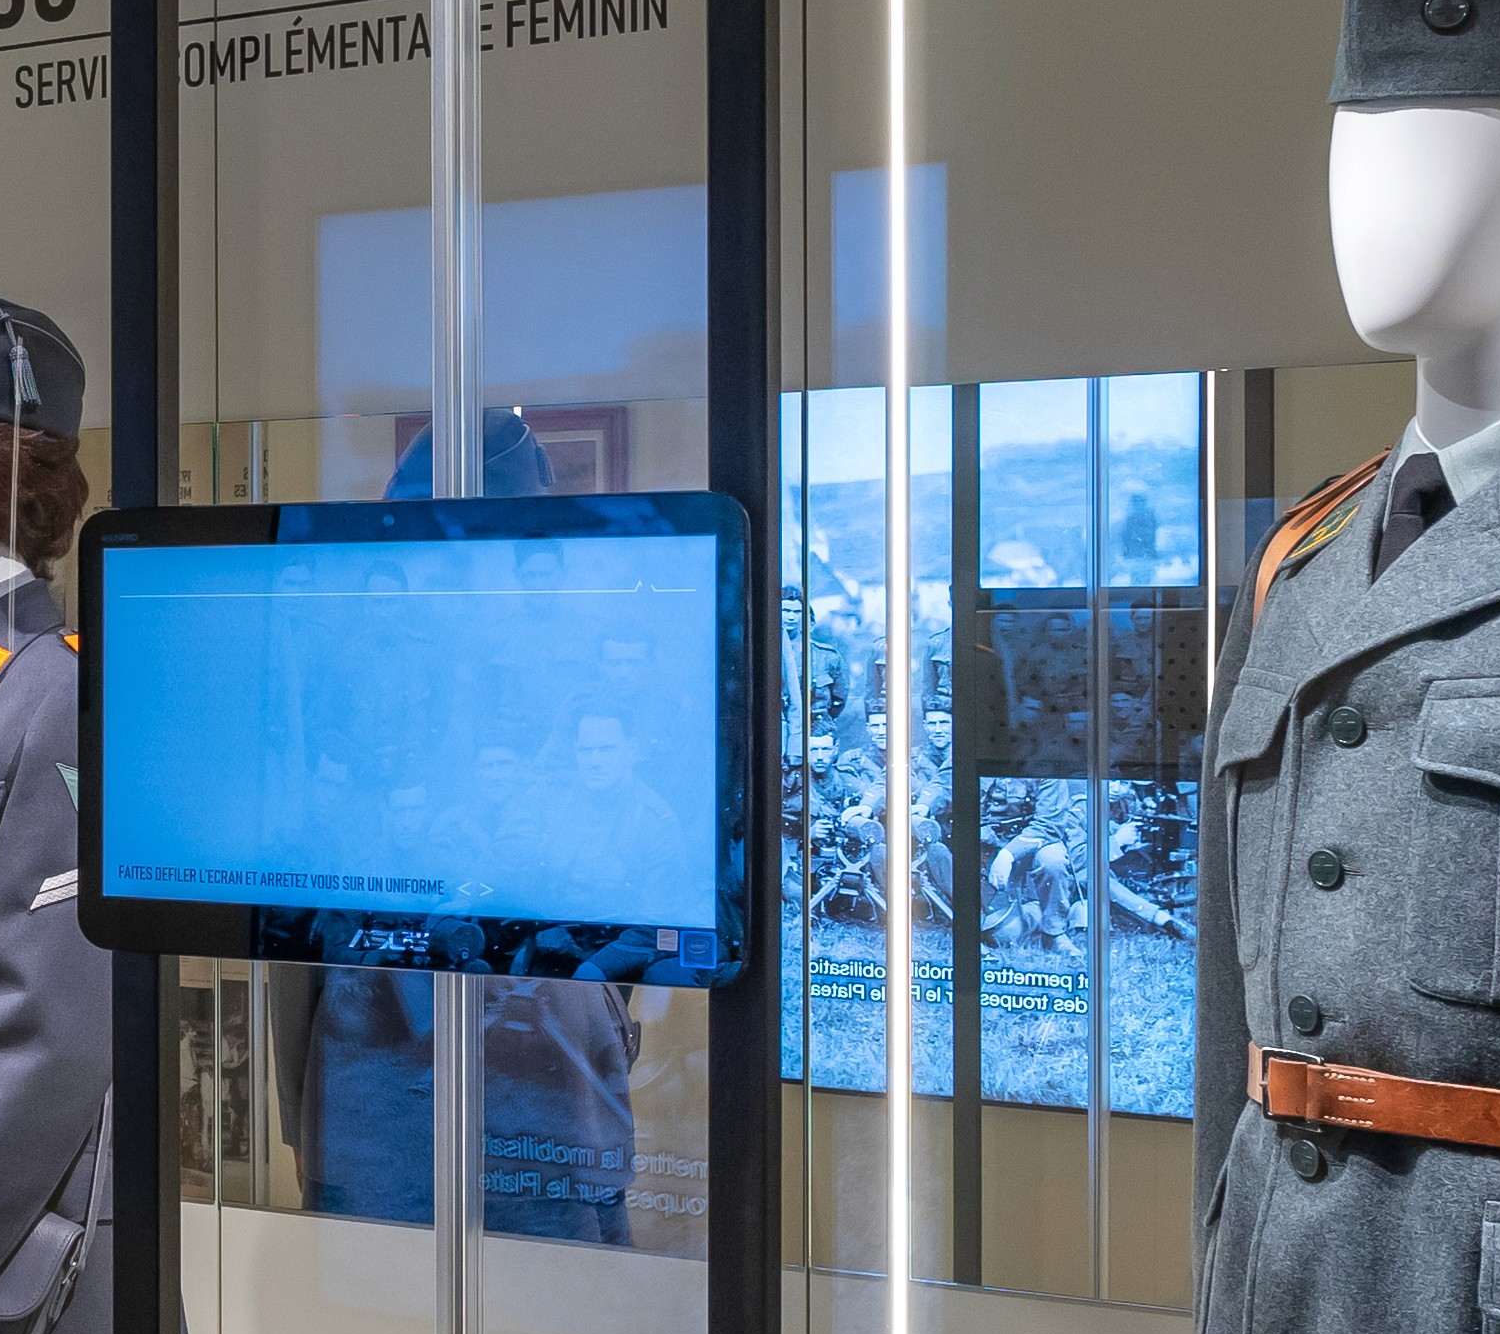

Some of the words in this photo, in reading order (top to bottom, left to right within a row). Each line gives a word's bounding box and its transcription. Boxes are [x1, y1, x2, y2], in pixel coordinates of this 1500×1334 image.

[15, 54, 108, 109] SERVI
[178, 3, 494, 88] OMPLÉMENTAE
[118, 865, 153, 881] FAITES
[155, 867, 197, 883] DEFILER
[199, 869, 243, 885] L'ECRAN
[245, 871, 258, 886] ET
[260, 872, 308, 889] ARRETEZ
[310, 874, 339, 890] VOUS
[342, 875, 365, 892] SUR
[367, 876, 383, 893] UN
[385, 877, 445, 896] UNIFORME
